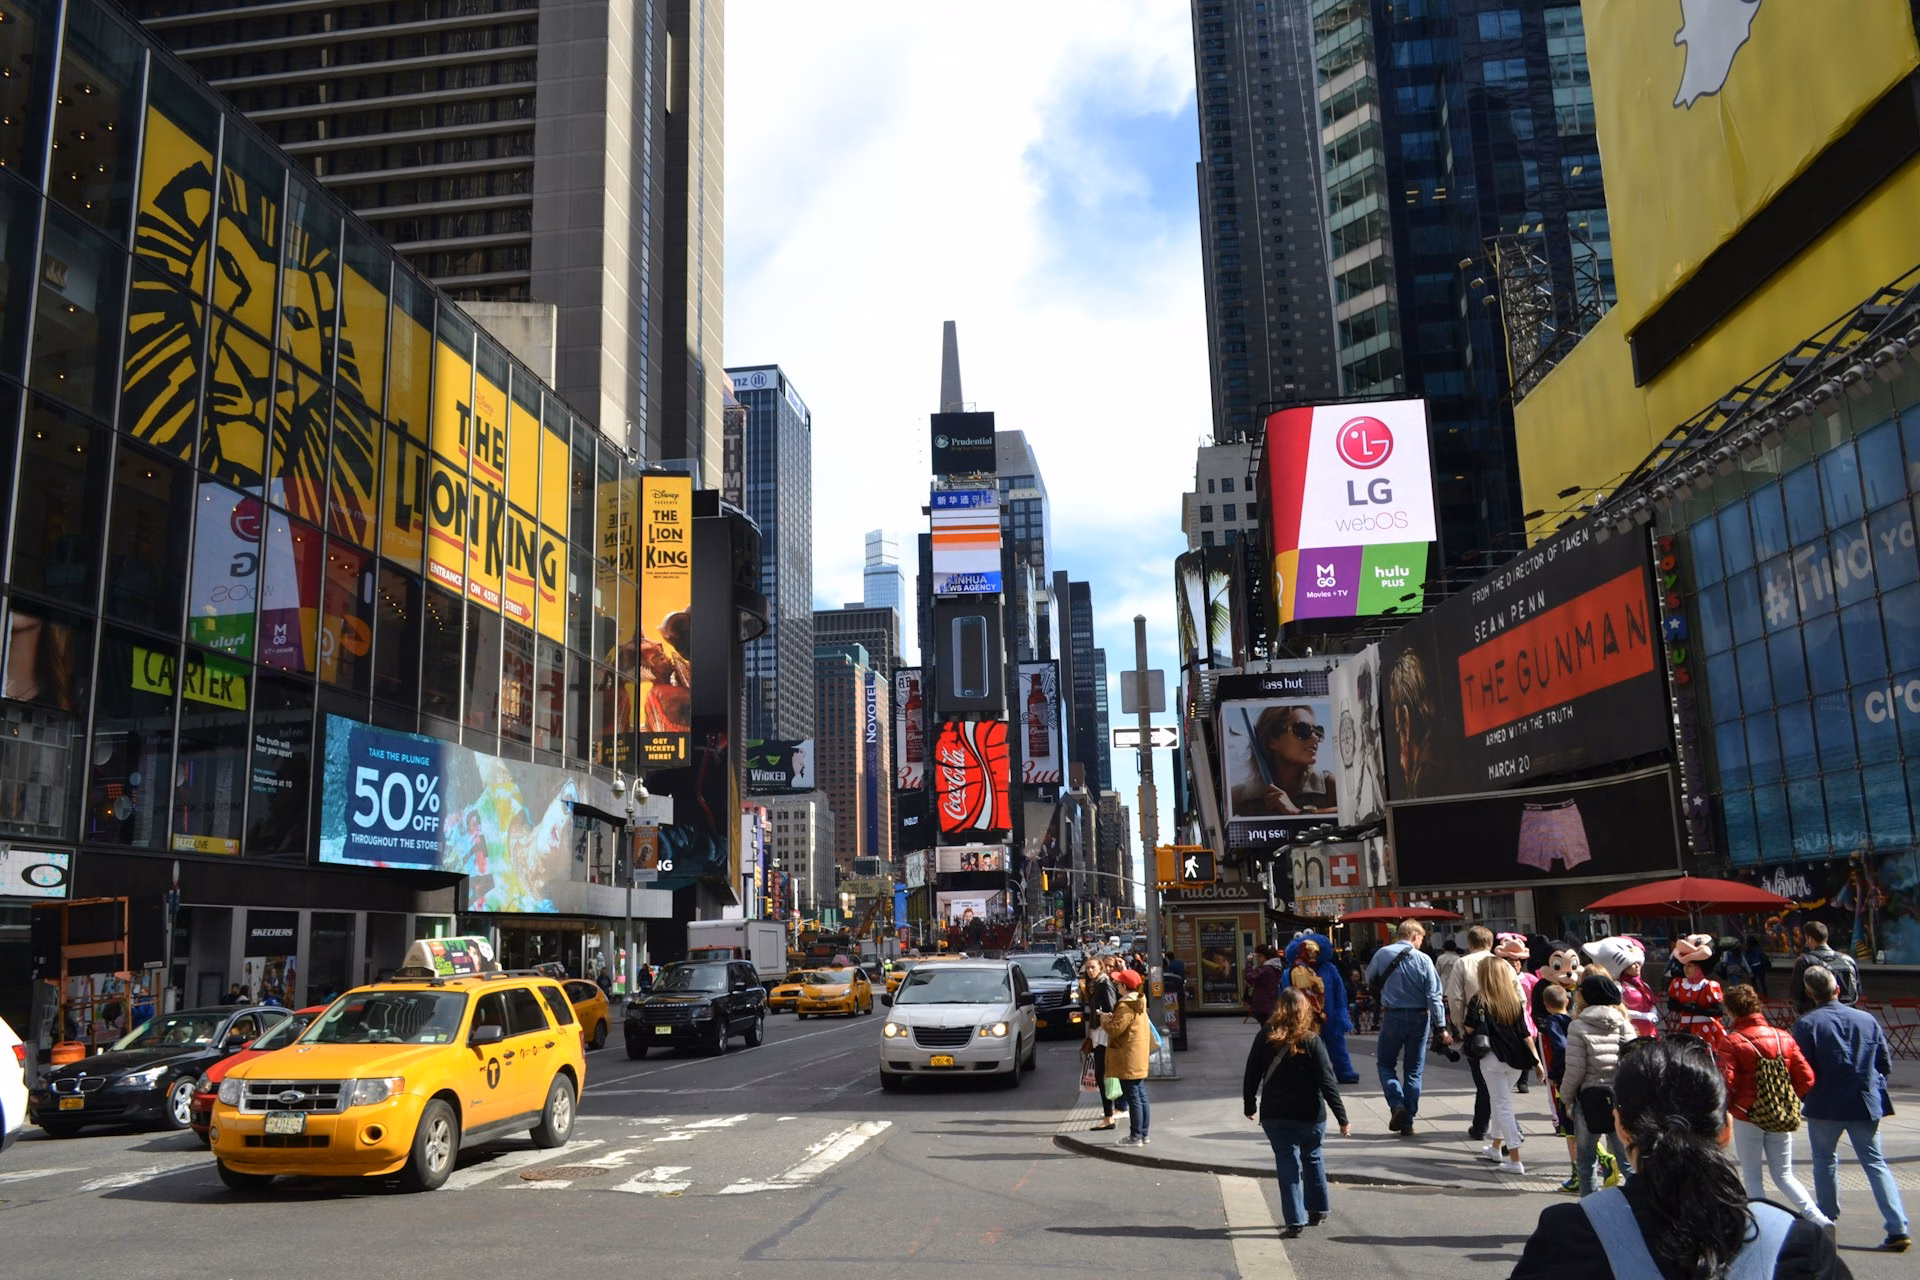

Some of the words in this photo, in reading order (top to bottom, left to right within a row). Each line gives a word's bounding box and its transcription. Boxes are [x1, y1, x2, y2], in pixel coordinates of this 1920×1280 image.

[456, 399, 504, 473] THE
[951, 437, 992, 446] Prudential
[651, 488, 679, 500] Disney
[1347, 477, 1393, 506] LG
[395, 418, 480, 547] LION
[485, 480, 557, 592] KING
[653, 510, 677, 521] THE
[1335, 511, 1408, 532] webOS
[649, 524, 683, 543] LION
[646, 545, 688, 569] KING
[1472, 586, 1490, 605] FROM
[1491, 576, 1505, 596] THE
[1506, 552, 1545, 587] DIRECTOR
[1547, 547, 1558, 562] OF
[1560, 527, 1589, 553] TAKEN
[1375, 565, 1410, 578] hulu
[429, 561, 463, 587] ENTRANCE
[470, 581, 481, 597] ON
[484, 587, 498, 605] 45TH
[505, 597, 523, 617] STREET
[963, 583, 996, 592] AGENCY
[1317, 577, 1337, 587] GO
[1381, 579, 1405, 587] PLUS
[1306, 590, 1330, 598] Movies
[1474, 611, 1505, 643] SEAN
[1511, 590, 1545, 622] PENN
[1464, 659, 1508, 714] THE
[1517, 598, 1647, 694] GUNMAN
[143, 650, 233, 702] CARTER
[1285, 677, 1303, 690] hut
[866, 680, 877, 744] NOVOTEL
[1486, 729, 1507, 746] ARMED
[1509, 722, 1528, 739] WITH
[1530, 715, 1544, 730] THE
[1546, 705, 1574, 724] TRUTH
[368, 747, 385, 759] TAKE
[386, 751, 400, 761] THE
[401, 754, 430, 766] PLUNGE
[1488, 760, 1516, 780] MARCH
[1518, 754, 1530, 774] 20
[285, 780, 293, 788] 10
[353, 766, 440, 832] 50%
[412, 815, 440, 832] OFF
[351, 833, 398, 847] THROUGHOUT
[400, 838, 414, 849] THE
[1248, 830, 1267, 841] hut
[251, 928, 293, 937] SKECHERS
